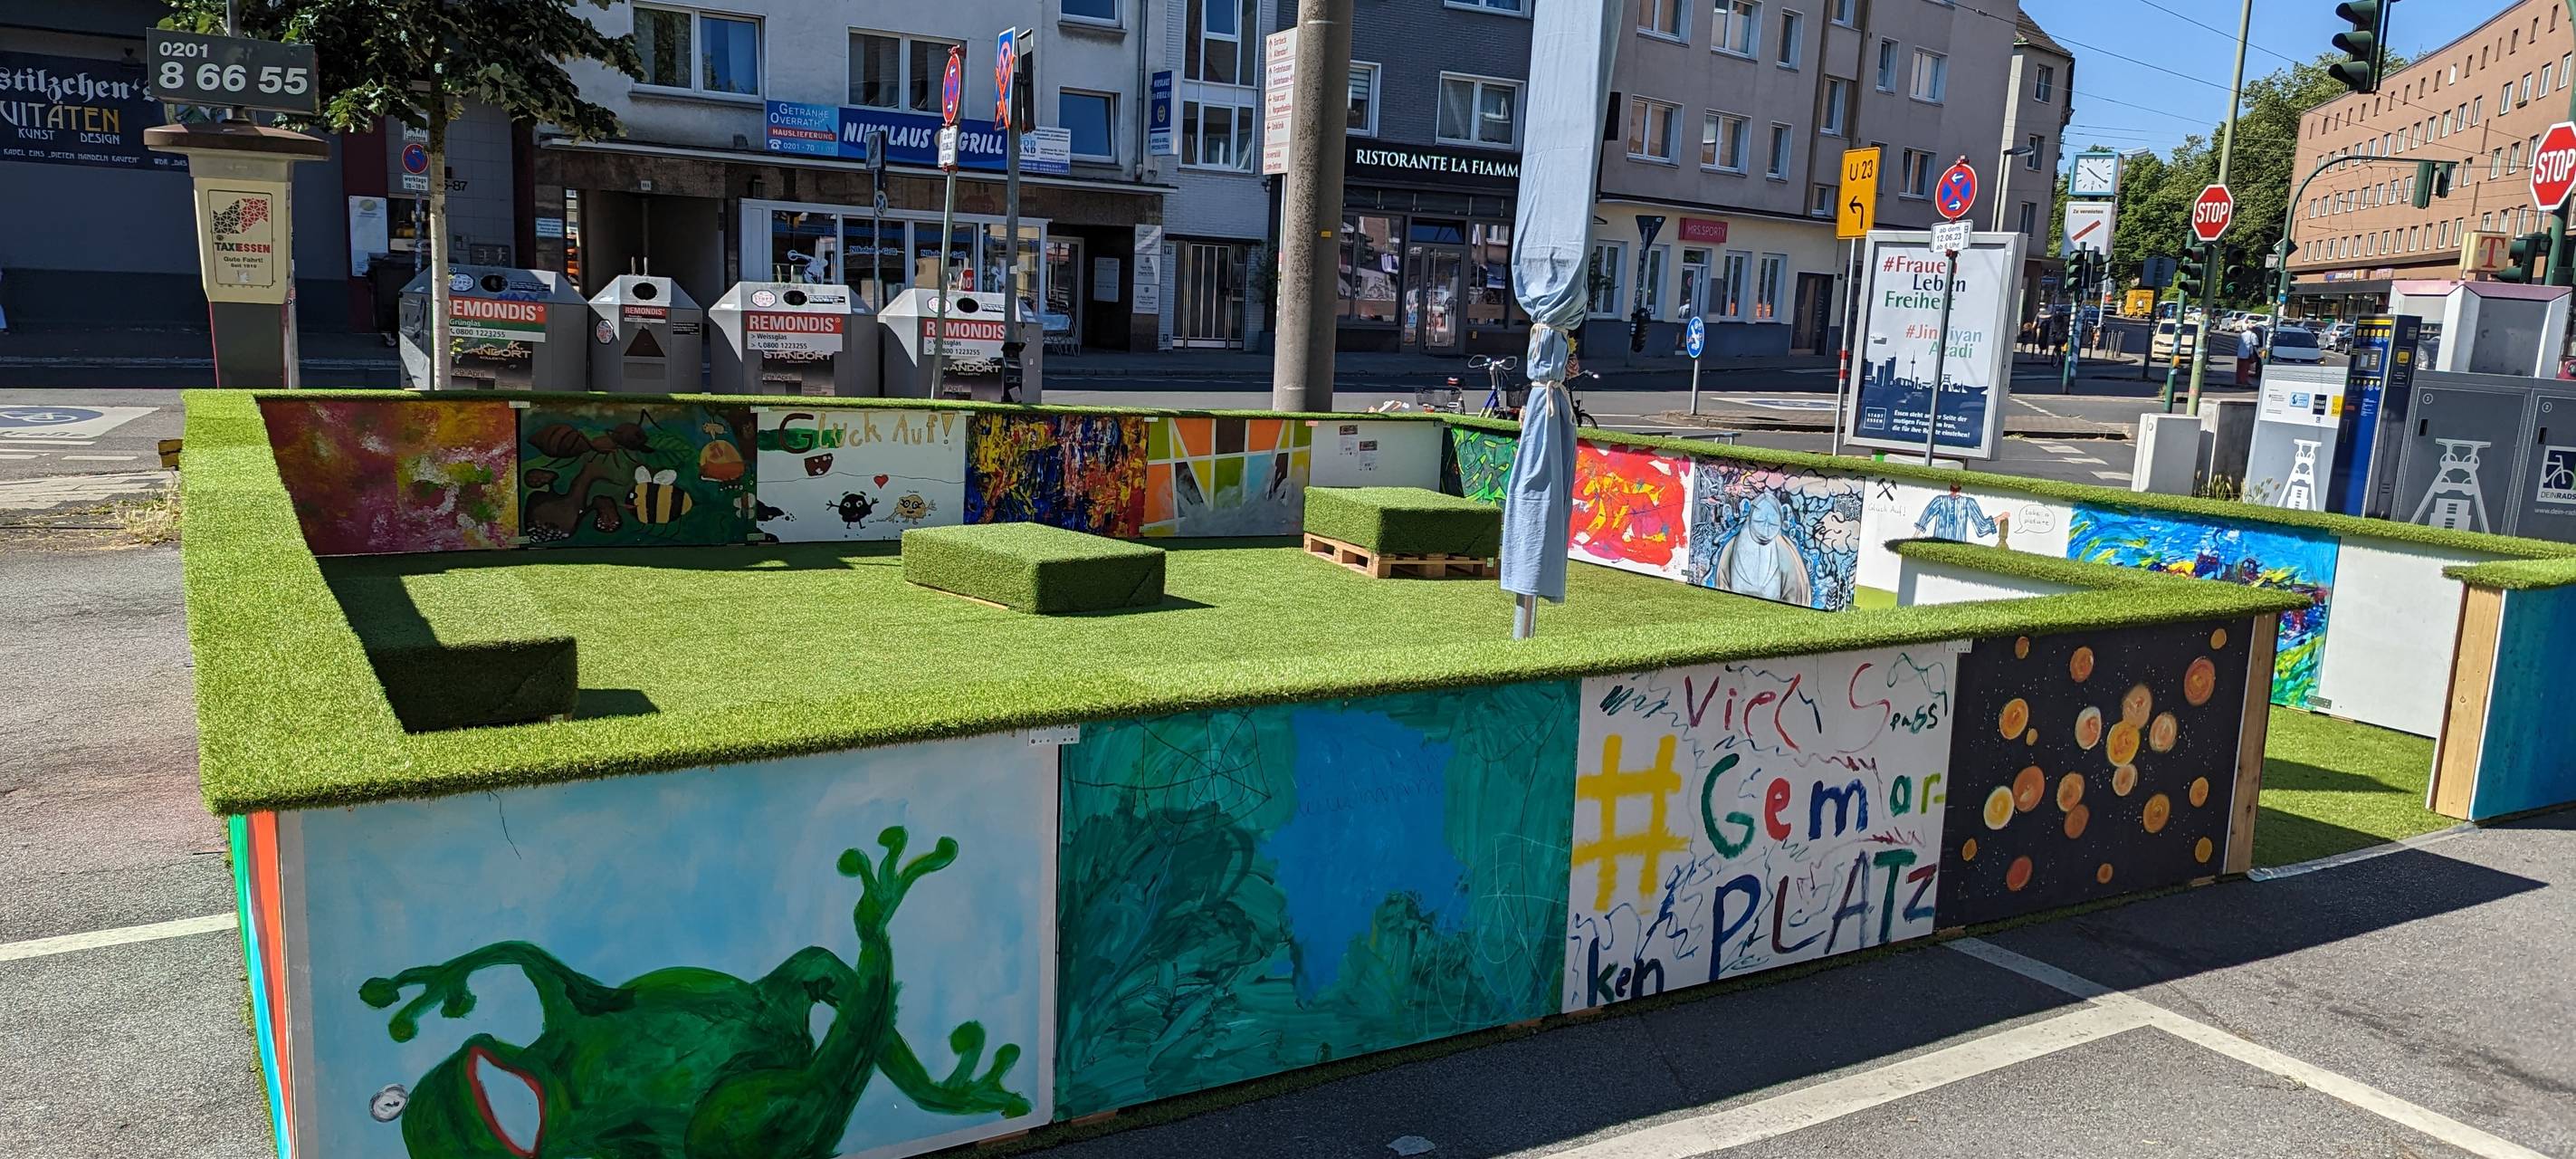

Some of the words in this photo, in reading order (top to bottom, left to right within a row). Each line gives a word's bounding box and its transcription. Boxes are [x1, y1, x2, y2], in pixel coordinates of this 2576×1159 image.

[159, 42, 208, 58] 0201
[158, 62, 184, 89] 8
[196, 63, 246, 91] 66
[258, 66, 308, 94] 55
[18, 128, 55, 140] KUNST
[81, 132, 119, 145] DESIGN
[773, 129, 833, 140] HAUSLIEFERUNG
[959, 132, 1003, 155] GRILL
[1356, 148, 1447, 171] RISTORANTE
[1451, 158, 1468, 173] LA
[1850, 163, 1858, 181] U
[1862, 159, 1874, 179] 23
[2536, 148, 2575, 184] STOP
[2197, 202, 2228, 224] STOP
[2480, 236, 2505, 268] T
[1913, 273, 1966, 292] Lebn
[1884, 290, 1955, 310] Freihet
[449, 300, 537, 321] EMONDIS
[625, 306, 663, 316] REMONDIS
[450, 318, 481, 328] Grünglas
[749, 315, 834, 332] REMONDIS
[926, 321, 1006, 339] RMONDIS
[476, 330, 506, 338] 1223255
[1906, 324, 1982, 344] #Jiniyan
[1942, 429, 1970, 438] einstehen!
[1587, 936, 1665, 1008] ken
[1709, 849, 1938, 981] PLATZ
